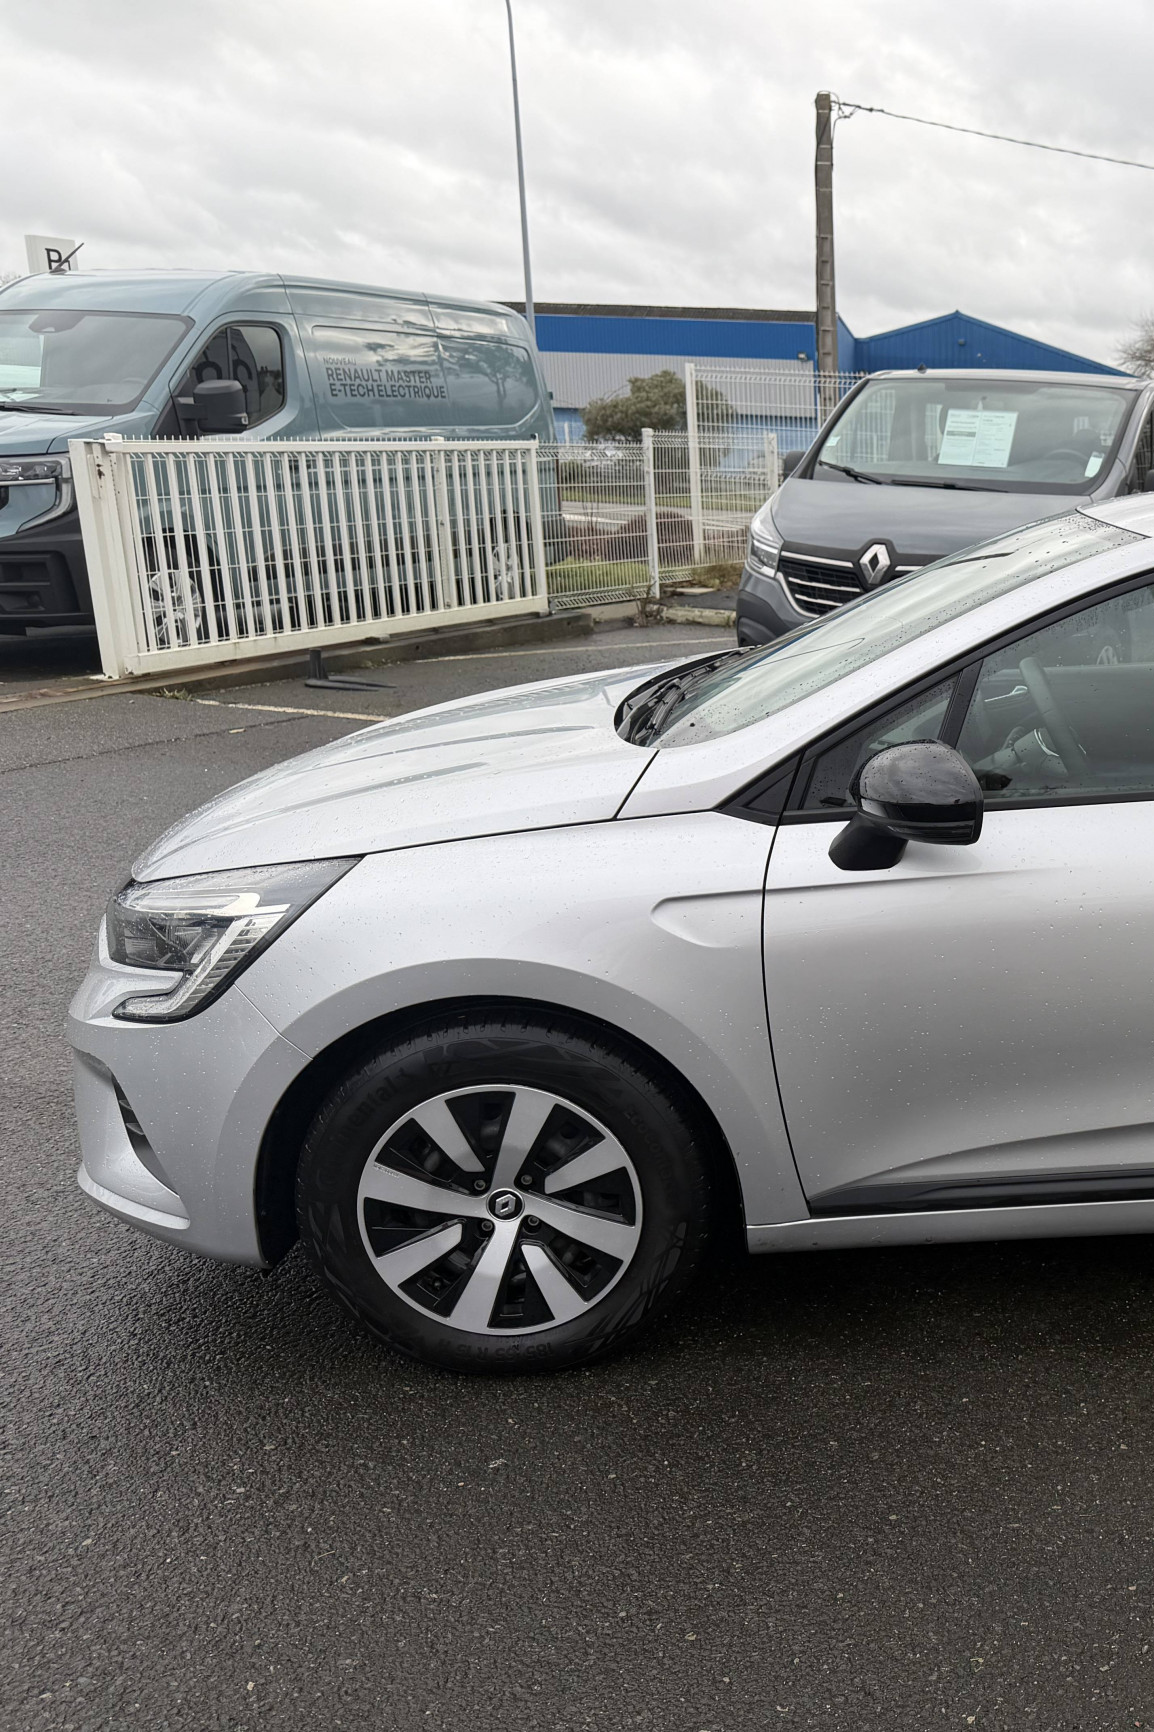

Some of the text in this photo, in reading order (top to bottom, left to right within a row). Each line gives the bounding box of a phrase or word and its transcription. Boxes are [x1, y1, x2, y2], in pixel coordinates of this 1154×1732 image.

[323, 357, 356, 366] NOUVEAU
[326, 367, 432, 384] RENAULT MASTER
[329, 383, 447, 400] E-TECH ELECTRIQUE
